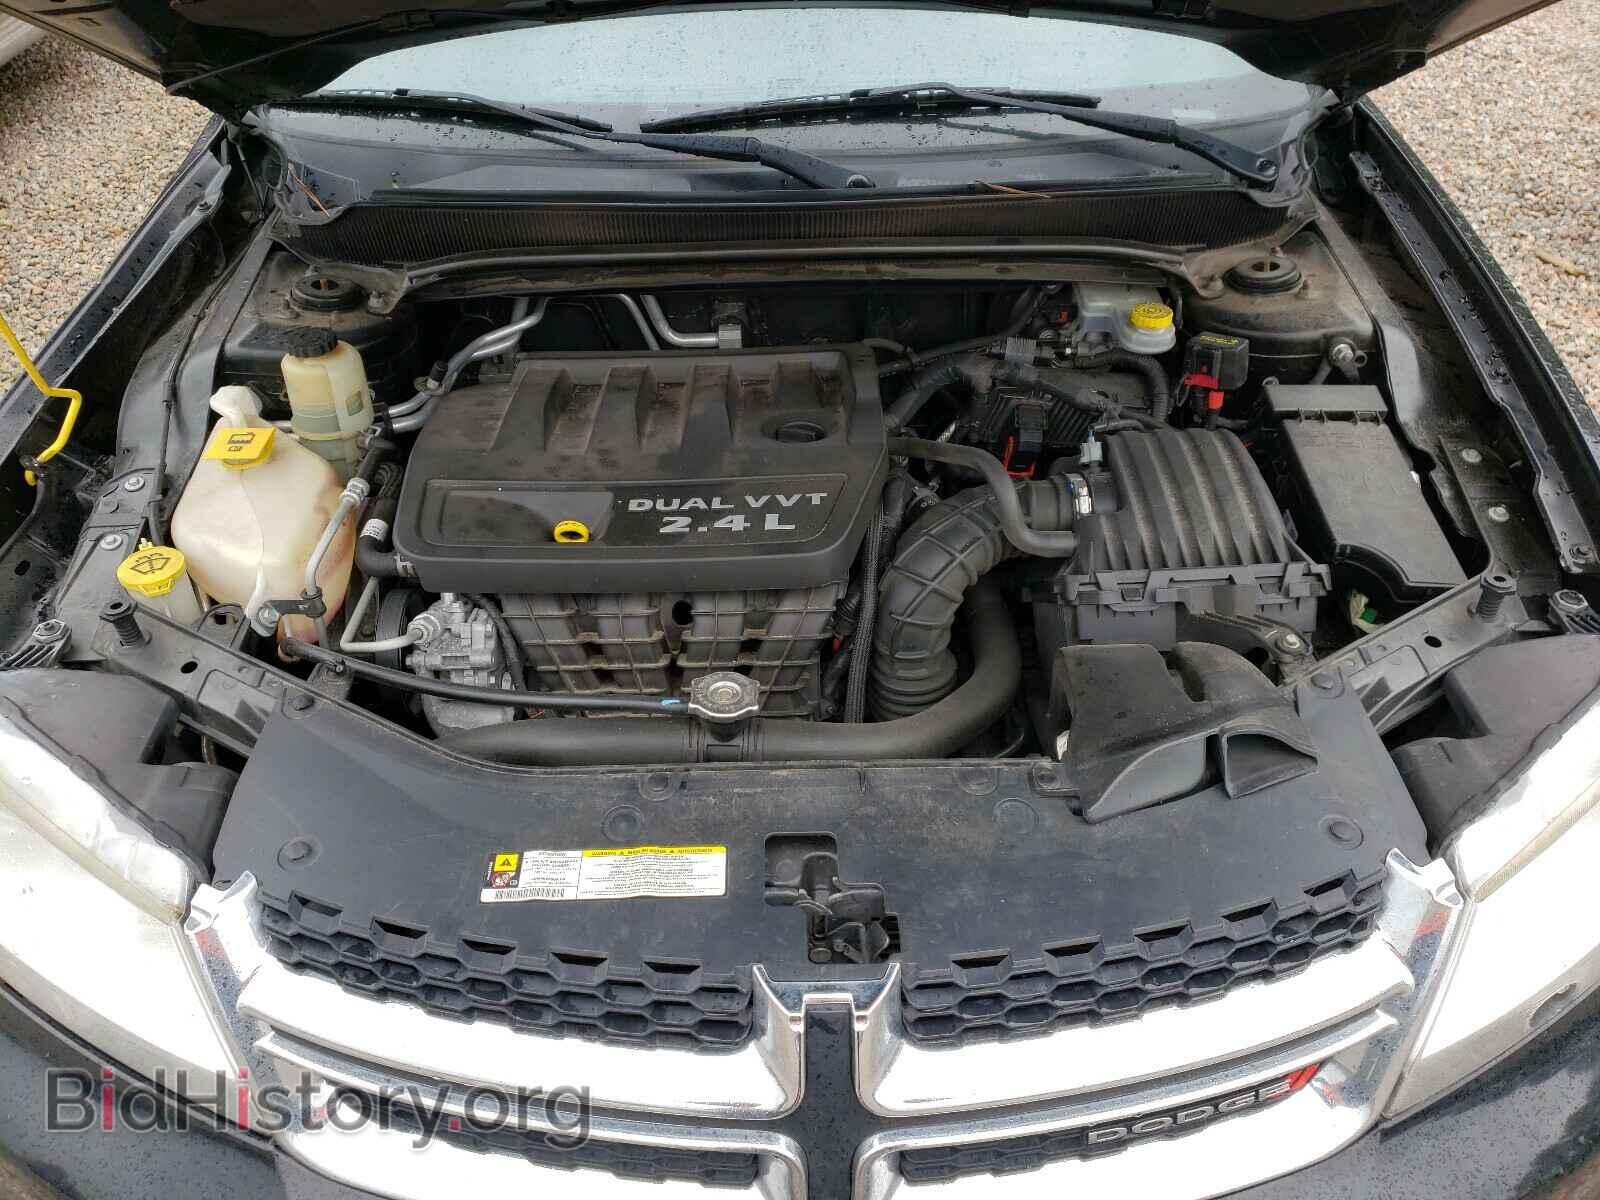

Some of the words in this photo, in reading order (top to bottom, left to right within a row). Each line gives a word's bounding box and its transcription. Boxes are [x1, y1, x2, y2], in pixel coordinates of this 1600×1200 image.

[627, 497, 735, 512] DUAL
[743, 492, 829, 508] VVT
[659, 514, 751, 533] 2.4
[1087, 1079, 1292, 1145] DODGE
